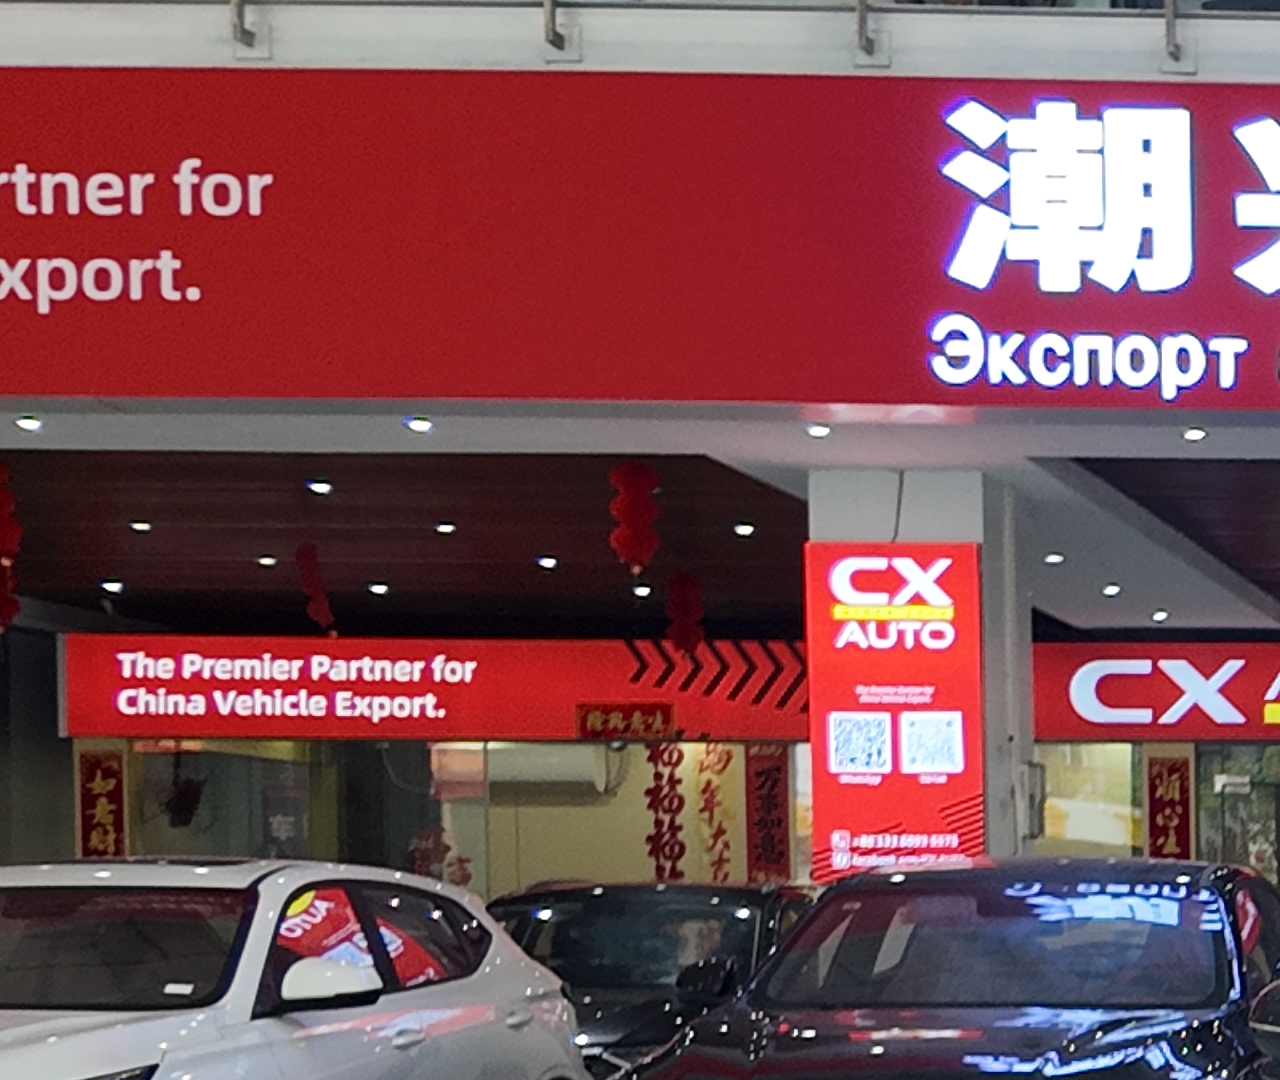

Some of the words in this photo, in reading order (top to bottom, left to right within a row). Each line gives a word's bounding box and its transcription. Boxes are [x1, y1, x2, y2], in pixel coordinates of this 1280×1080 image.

[0, 163, 155, 216] tner
[172, 157, 274, 217] for
[0, 249, 202, 315] xport.
[928, 312, 1250, 402] Экспорт
[828, 556, 954, 606] CX
[834, 620, 956, 650] AUTO
[116, 651, 176, 680] The
[181, 652, 304, 681] Premier
[310, 654, 426, 683] Partner
[430, 654, 478, 683] for
[1068, 658, 1248, 725] CX
[117, 687, 207, 716] China
[212, 688, 328, 717] Vehicle
[334, 690, 446, 722] Export.
